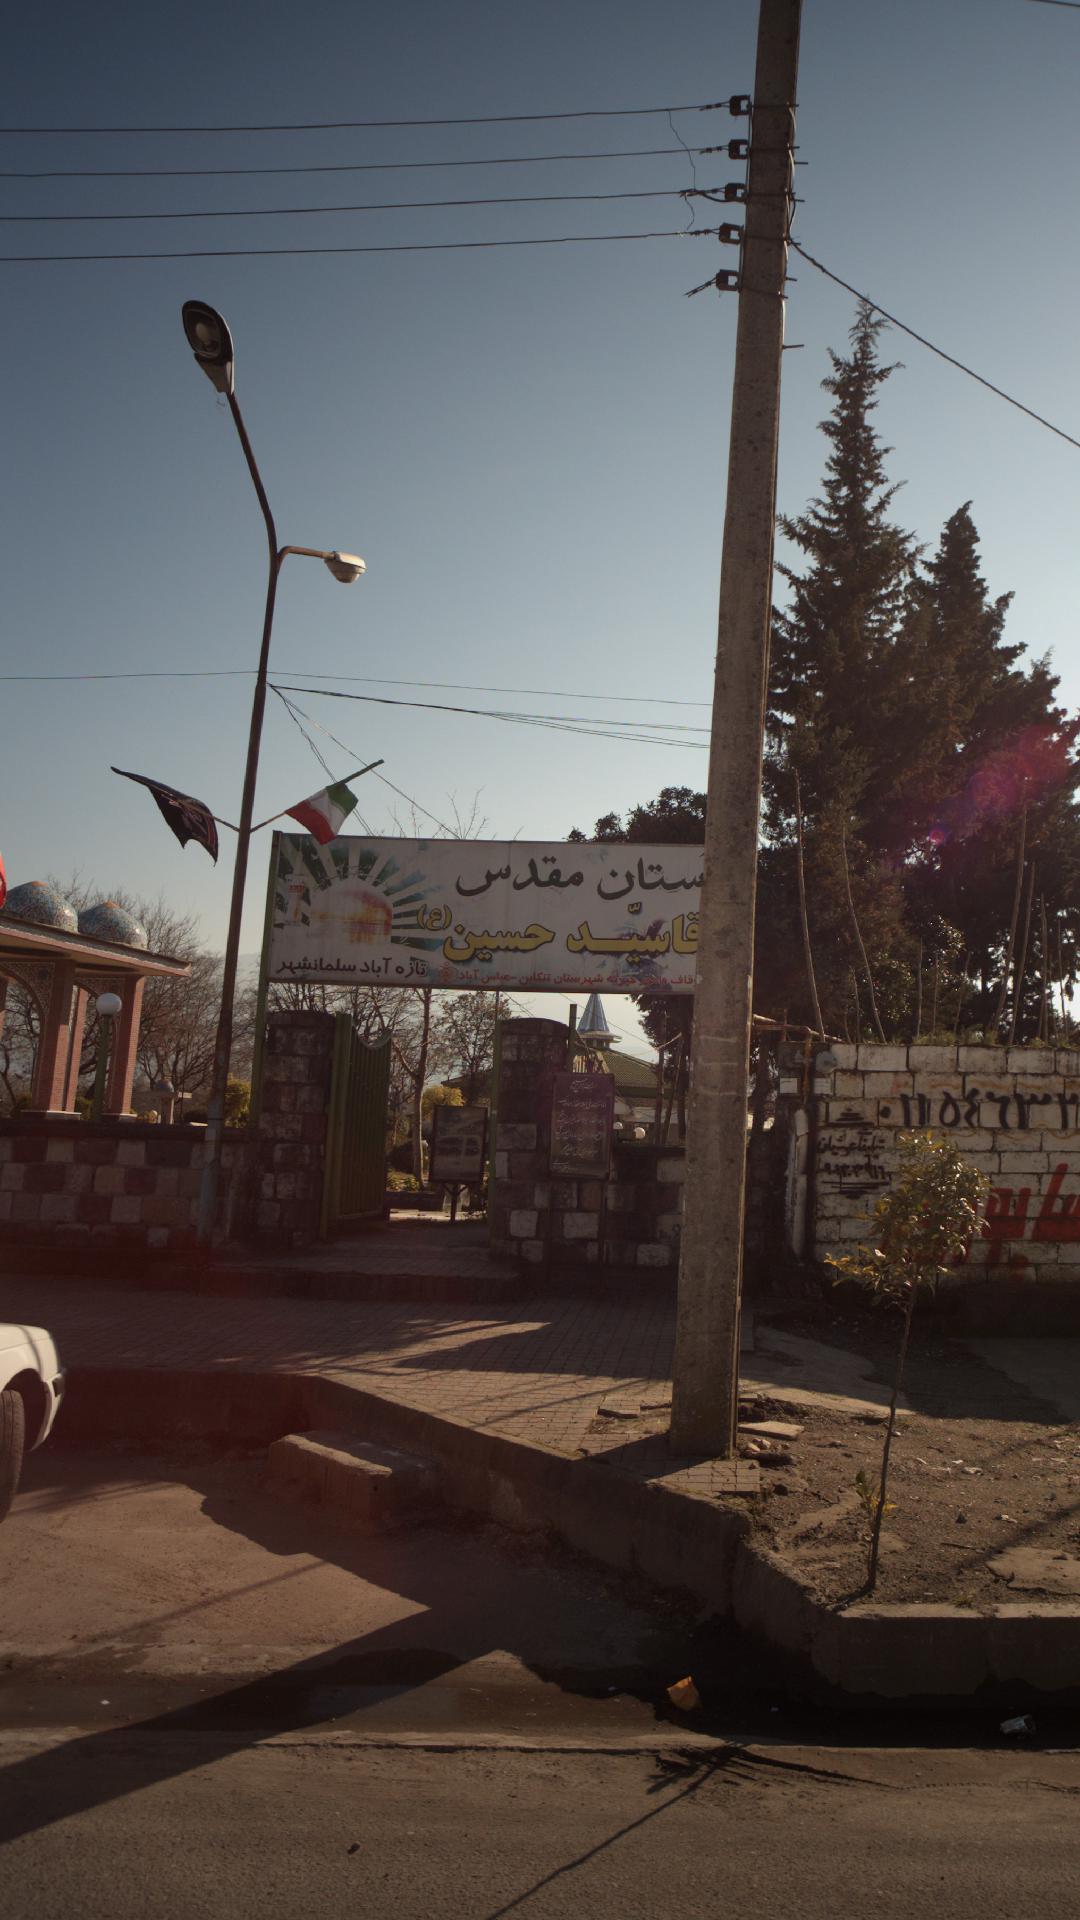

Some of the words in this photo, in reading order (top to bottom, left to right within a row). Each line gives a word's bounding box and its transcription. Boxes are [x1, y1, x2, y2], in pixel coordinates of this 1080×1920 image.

[455, 855, 584, 897] مقدس
[597, 856, 704, 900] ستان
[416, 903, 453, 931] (ع)
[442, 923, 556, 962] حسین
[276, 957, 356, 974] سلمانشهر
[360, 957, 392, 978] آباد
[395, 958, 427, 977] تازه
